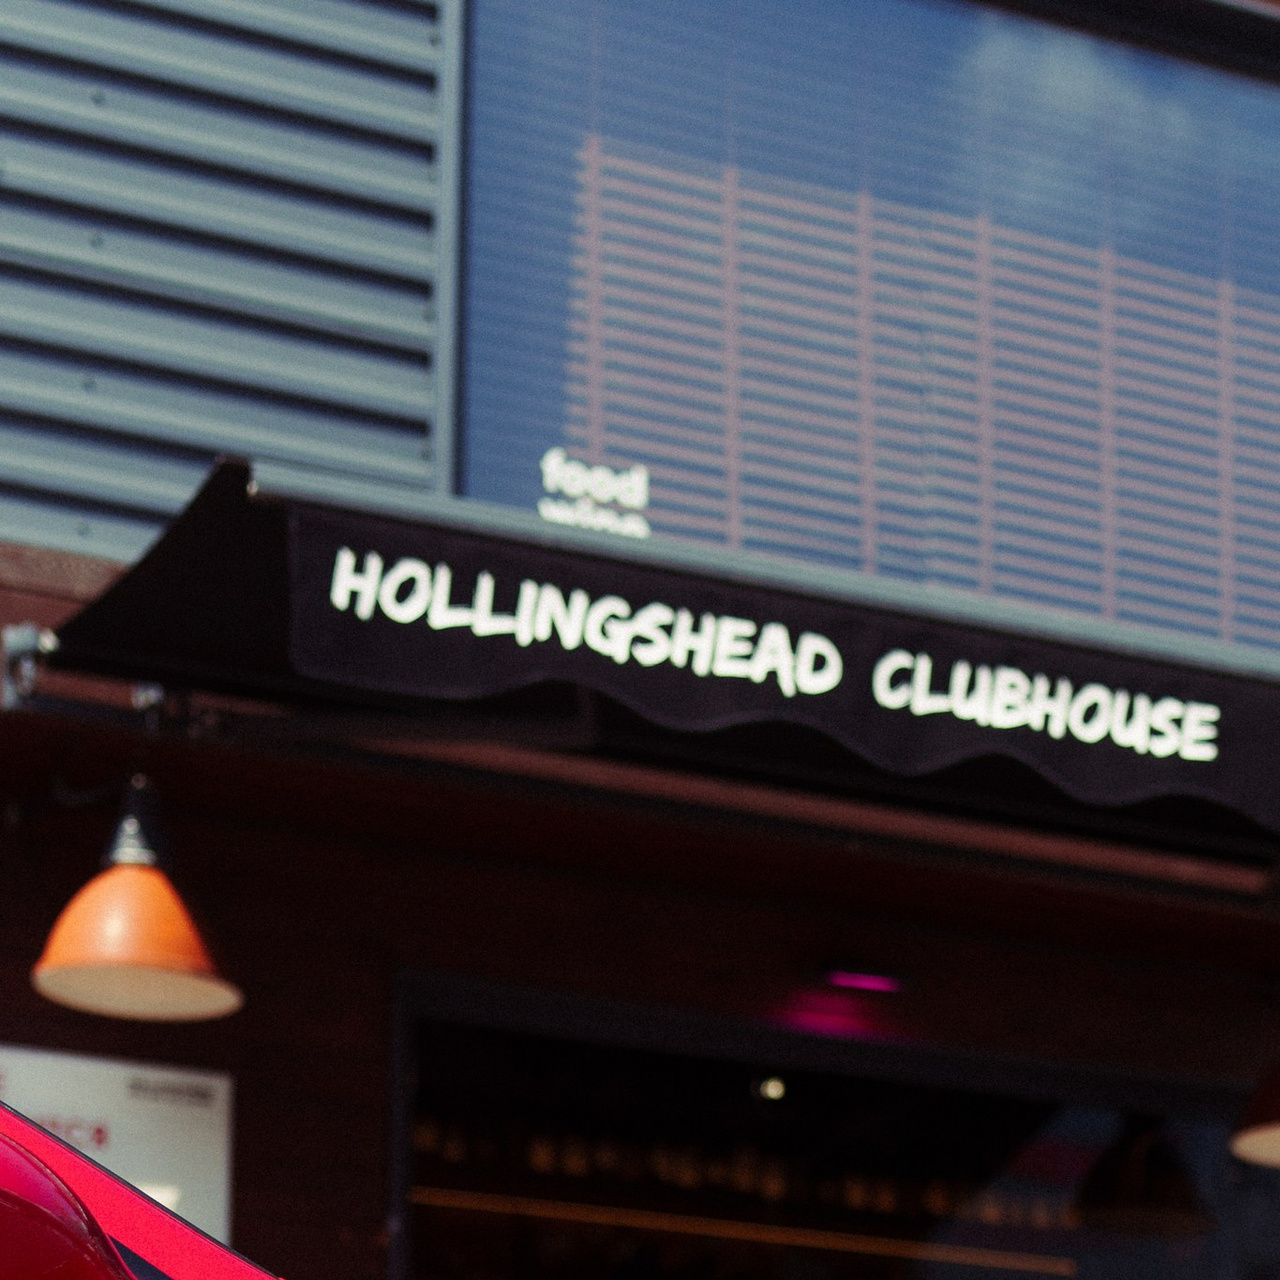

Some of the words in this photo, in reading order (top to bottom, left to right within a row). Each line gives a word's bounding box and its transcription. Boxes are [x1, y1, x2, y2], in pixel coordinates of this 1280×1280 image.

[539, 446, 649, 510] food
[330, 546, 843, 697] HOLLINGSHEAD
[872, 648, 1220, 762] CLUBHOUSE
